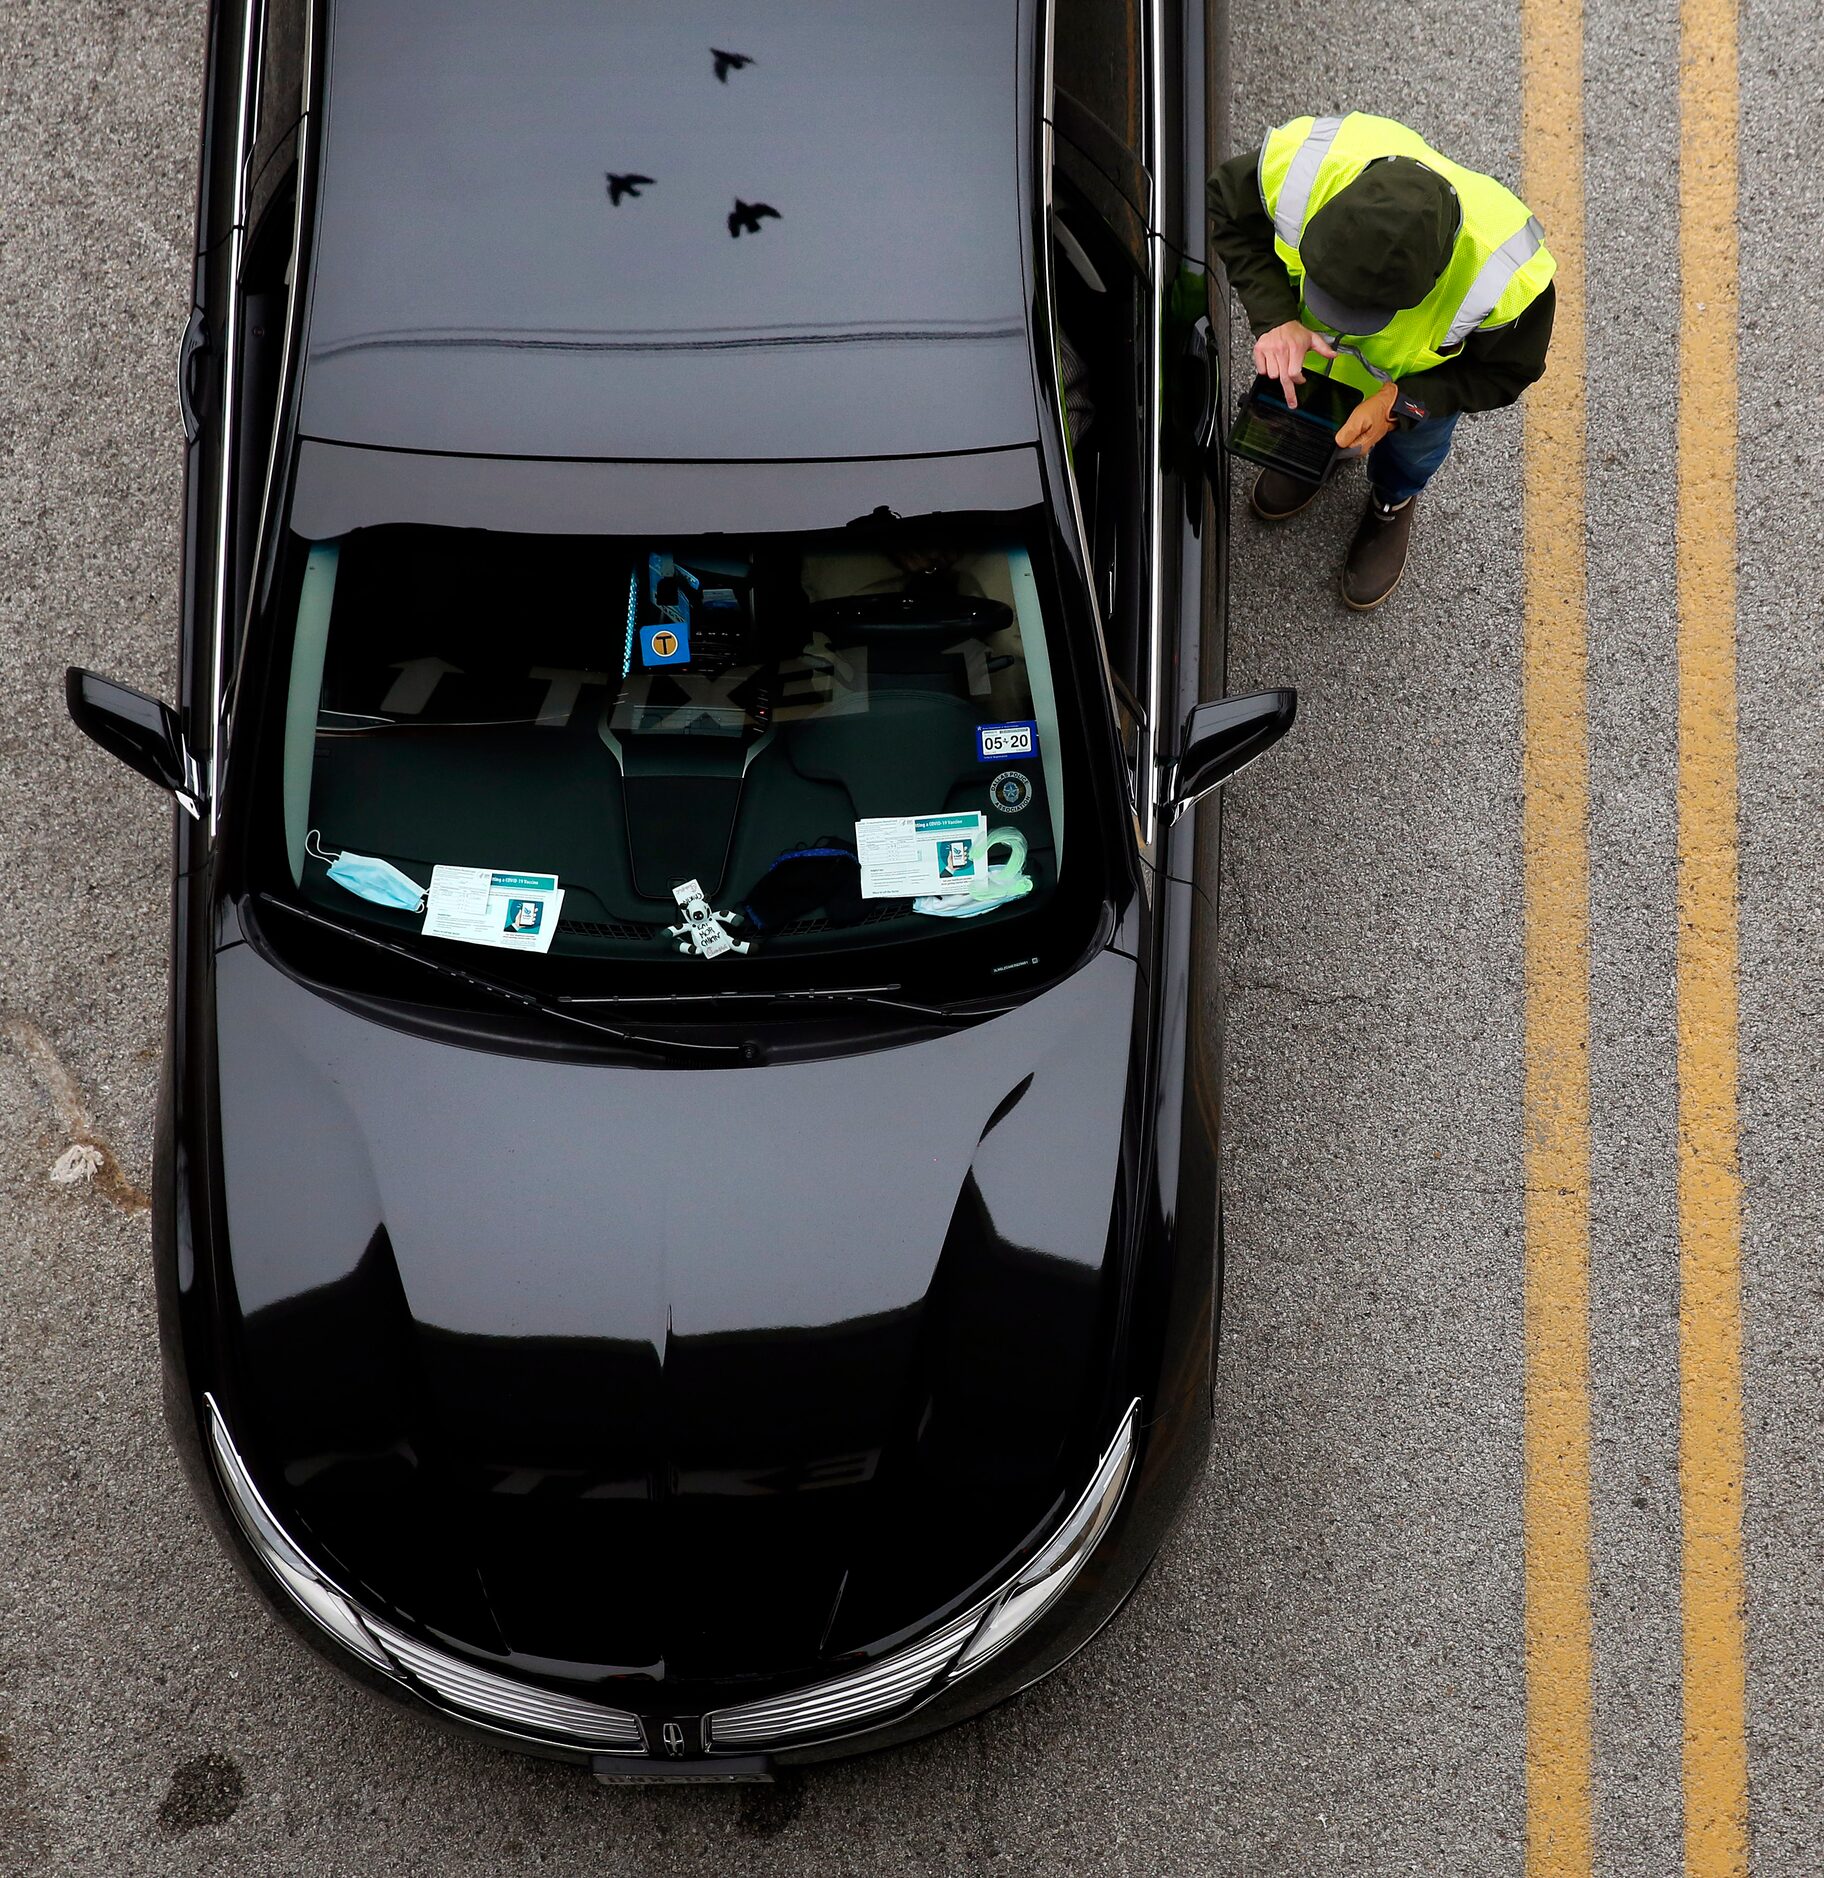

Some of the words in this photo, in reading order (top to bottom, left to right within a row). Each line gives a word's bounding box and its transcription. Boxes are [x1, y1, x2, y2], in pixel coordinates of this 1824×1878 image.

[655, 635, 673, 655] T
[984, 736, 1003, 750] 05
[1010, 734, 1028, 748] 20
[990, 771, 1009, 792] DALLAS
[1009, 771, 1030, 785] POLICE
[995, 794, 1031, 813] ASSOCIATION
[699, 927, 715, 938] MOR
